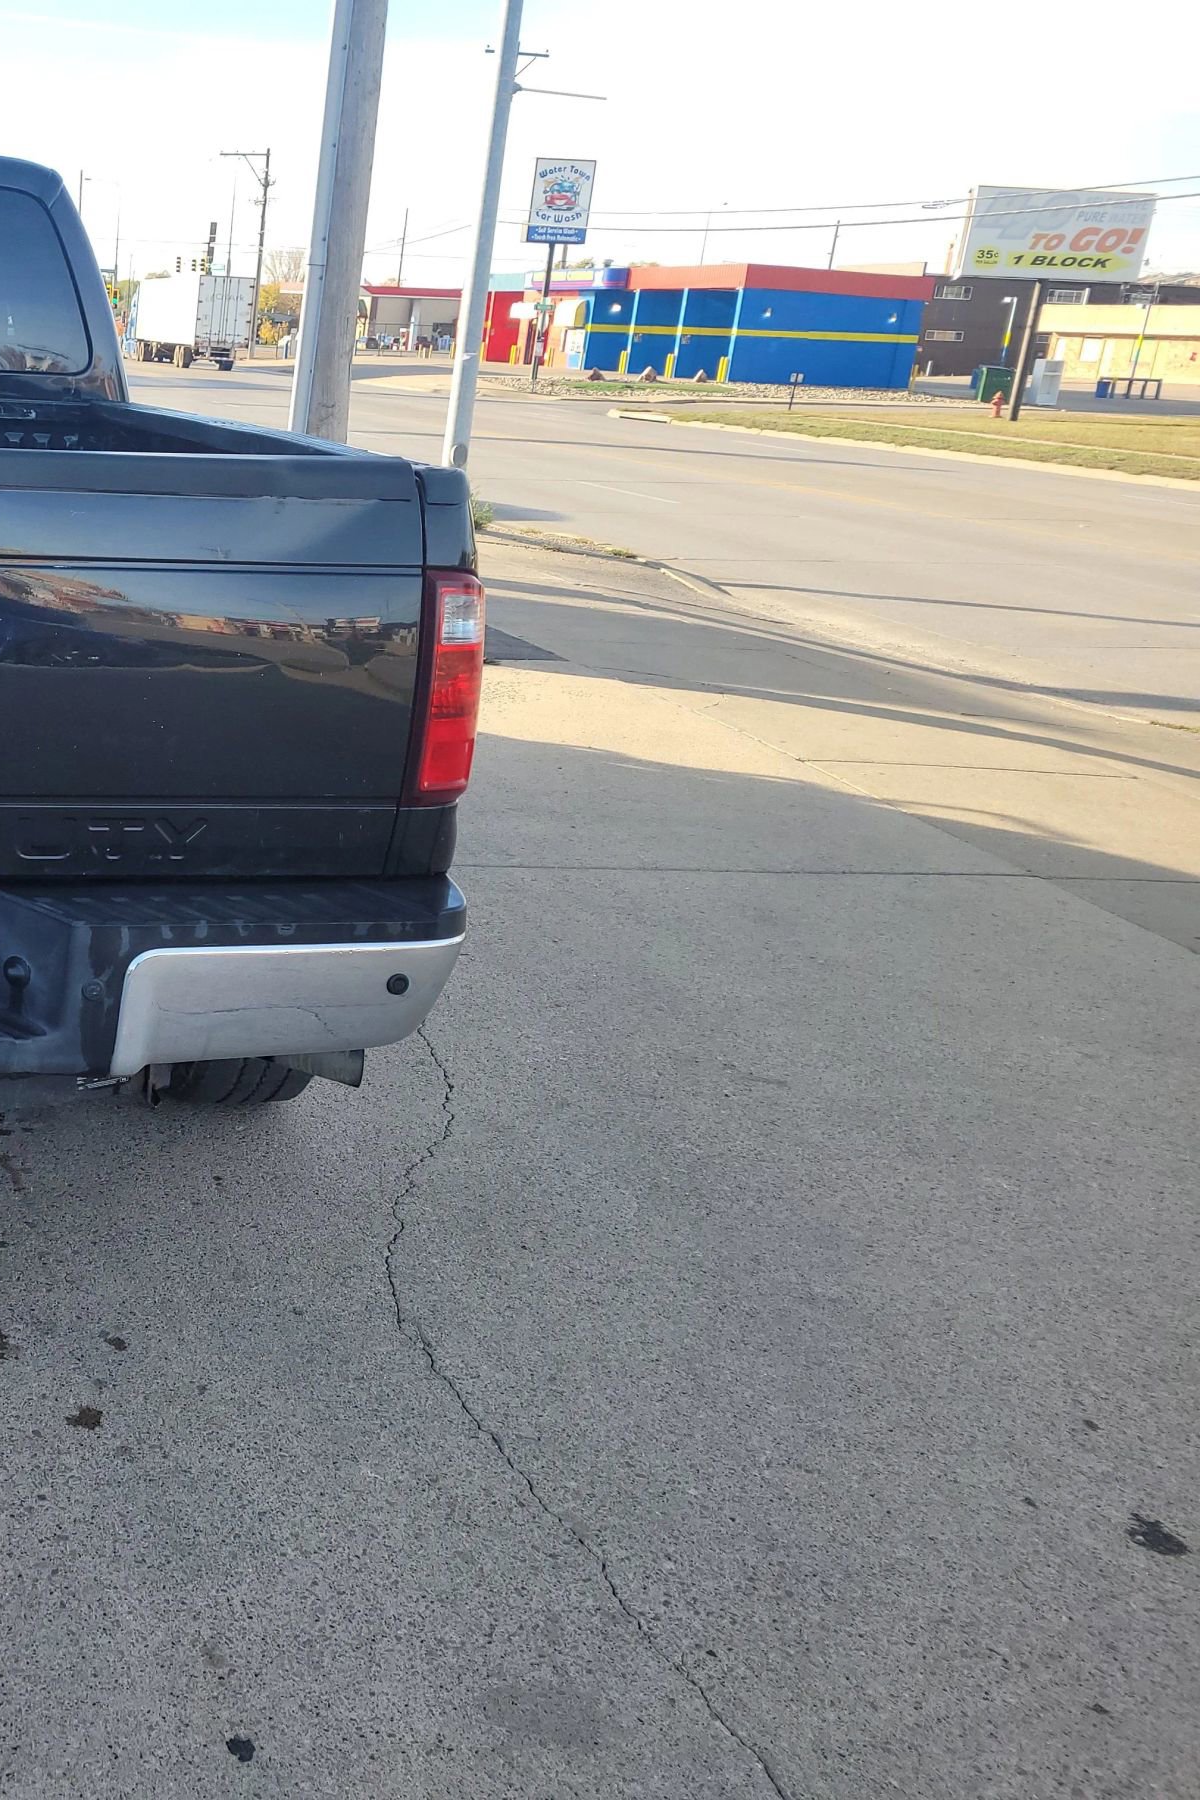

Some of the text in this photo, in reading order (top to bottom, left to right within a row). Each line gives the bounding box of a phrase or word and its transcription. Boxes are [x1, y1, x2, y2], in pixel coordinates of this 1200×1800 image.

[539, 165, 591, 181] Water Town
[554, 212, 582, 223] Wash
[1076, 210, 1109, 223] PURE
[1028, 226, 1146, 254] TO GO!
[1012, 254, 1112, 268] 1 BLOCK
